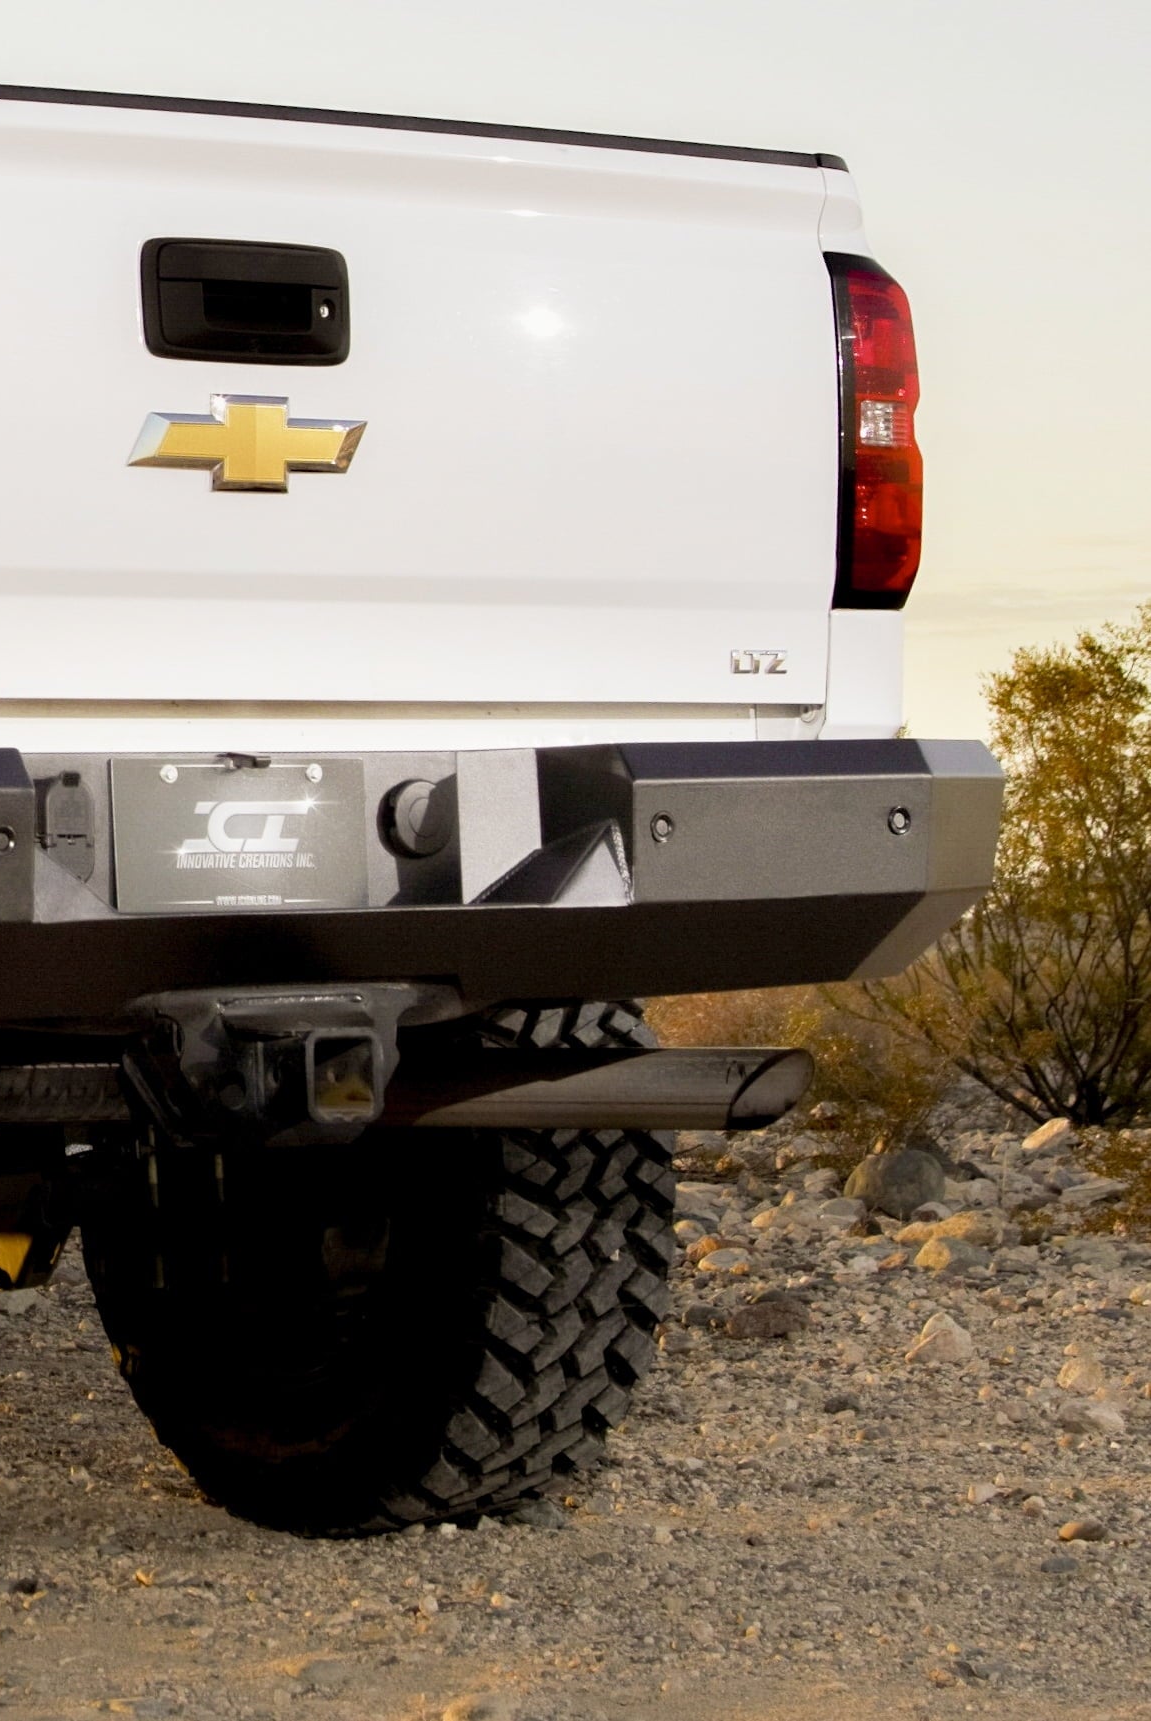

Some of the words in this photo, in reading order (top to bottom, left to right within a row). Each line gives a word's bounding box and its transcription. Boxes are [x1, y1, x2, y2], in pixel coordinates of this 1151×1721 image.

[730, 649, 787, 674] LTZ
[176, 853, 236, 869] INNOVATIVE
[238, 853, 294, 868] CREATIONS
